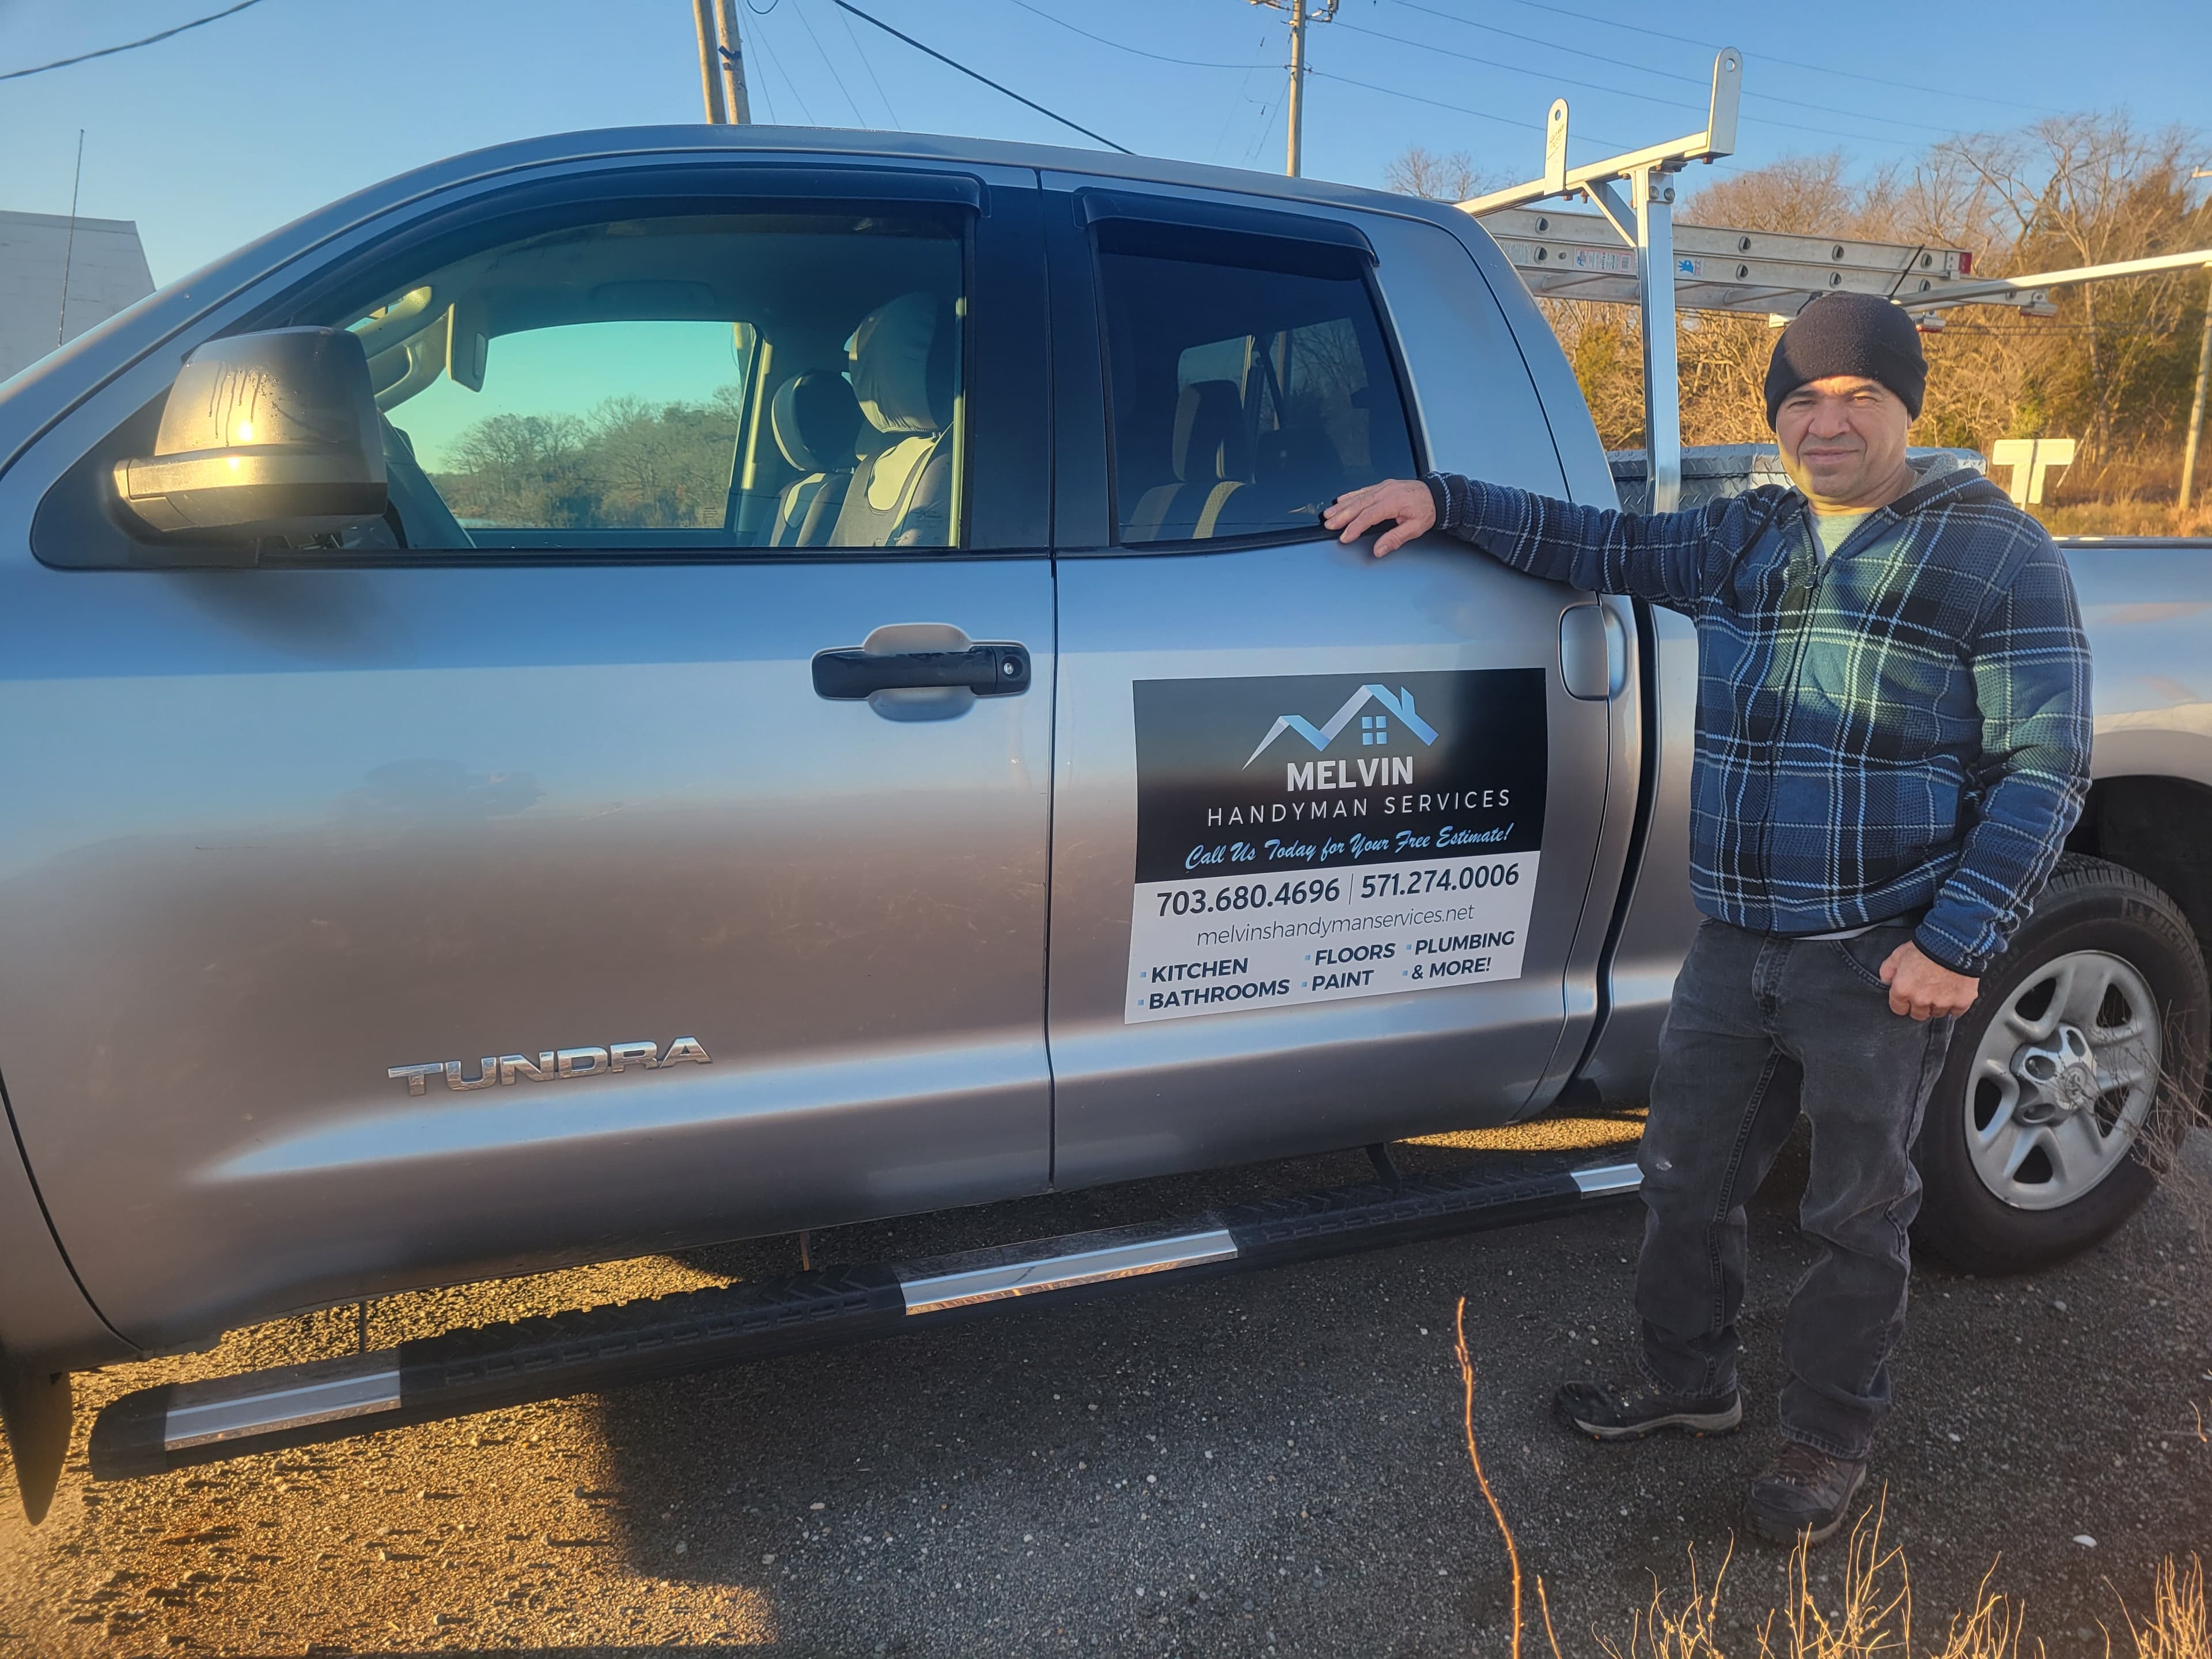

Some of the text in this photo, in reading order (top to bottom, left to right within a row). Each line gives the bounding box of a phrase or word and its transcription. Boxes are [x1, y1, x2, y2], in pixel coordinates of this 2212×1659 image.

[1286, 756, 1413, 792] MELVIN
[1207, 789, 1510, 827] HANDYMAN SERVICES
[1185, 822, 1515, 870] Call Us Today for Your Free Estimate!
[1157, 862, 1519, 916] 703.680.4696 571.274.0006
[1197, 904, 1475, 946] melvinshandymanservices.net
[1315, 942, 1396, 967] FLOORS
[1415, 930, 1516, 956] PLUMBING
[1151, 957, 1249, 984] KITCHEN
[1311, 969, 1375, 992] PAINT
[1411, 957, 1491, 980] & MORE!
[1148, 979, 1290, 1010] BATHROOMS
[387, 1035, 713, 1097] TUNDRA
